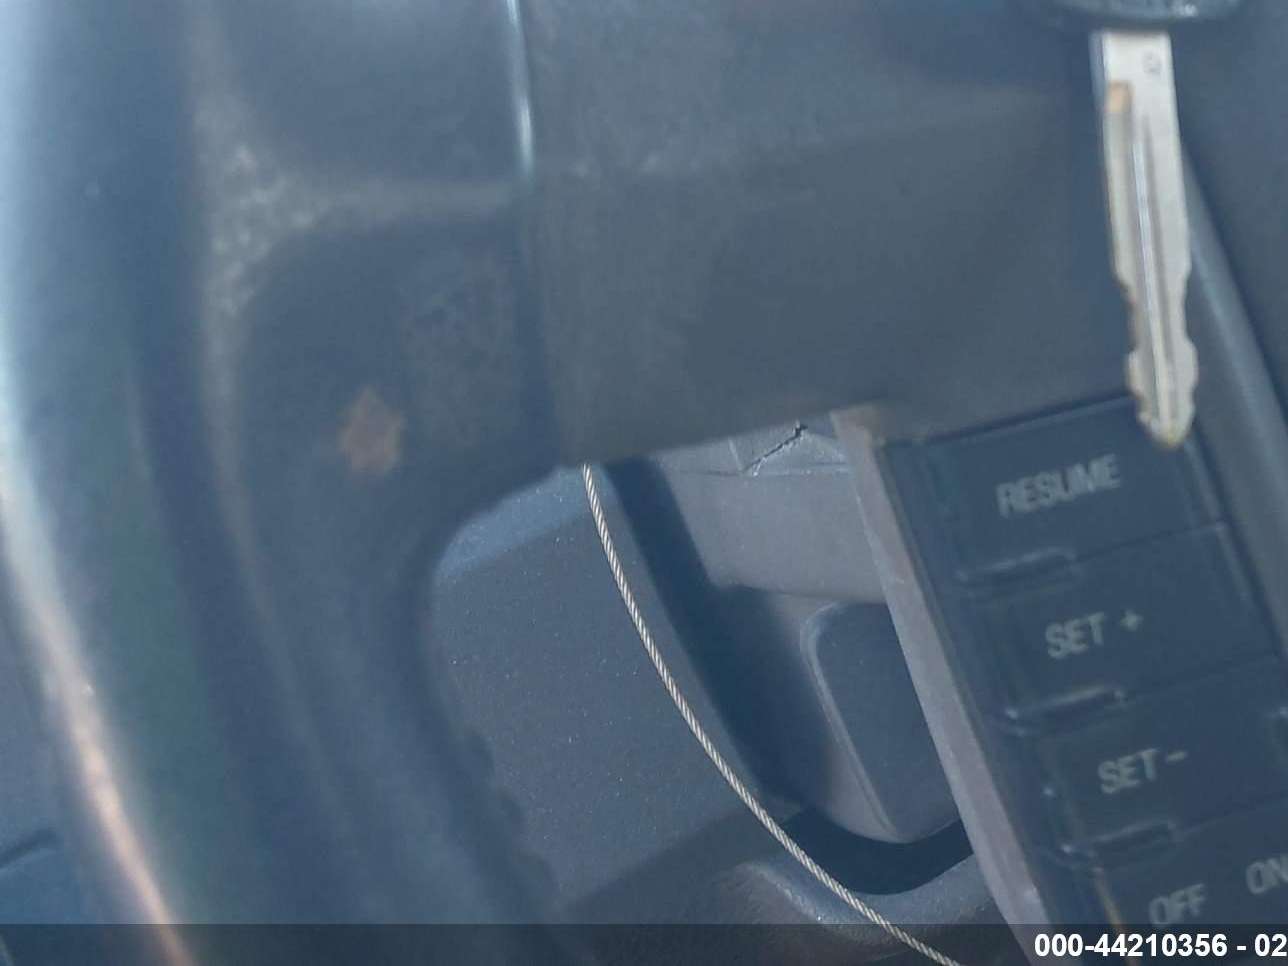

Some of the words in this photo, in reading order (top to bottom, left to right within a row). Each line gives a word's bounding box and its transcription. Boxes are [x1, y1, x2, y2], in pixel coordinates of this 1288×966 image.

[996, 454, 1120, 518] RESUME
[1044, 611, 1106, 660] SET
[1148, 884, 1207, 930] OFF
